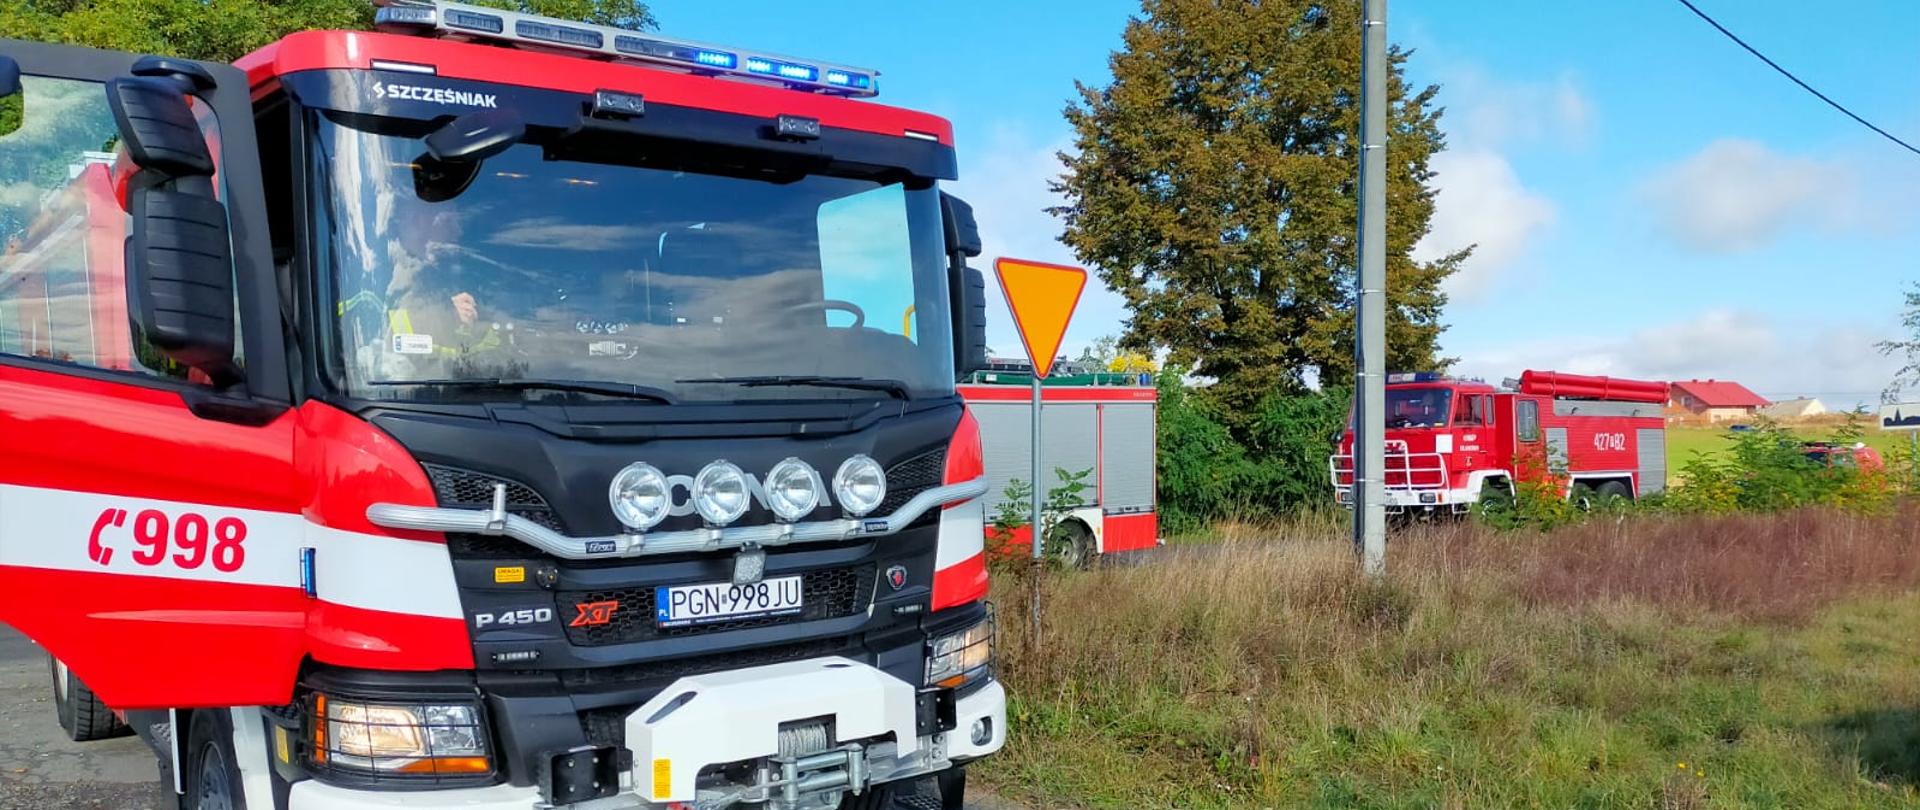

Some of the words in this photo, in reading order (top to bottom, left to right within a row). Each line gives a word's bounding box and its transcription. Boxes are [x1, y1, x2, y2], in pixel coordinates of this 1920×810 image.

[387, 84, 498, 108] SZCZĘŚNIAK
[132, 508, 247, 573] 998
[671, 586, 721, 618] PGN
[728, 579, 800, 612] 998JU
[475, 613, 494, 628] P
[498, 608, 552, 626] 450
[568, 600, 620, 627] XT
